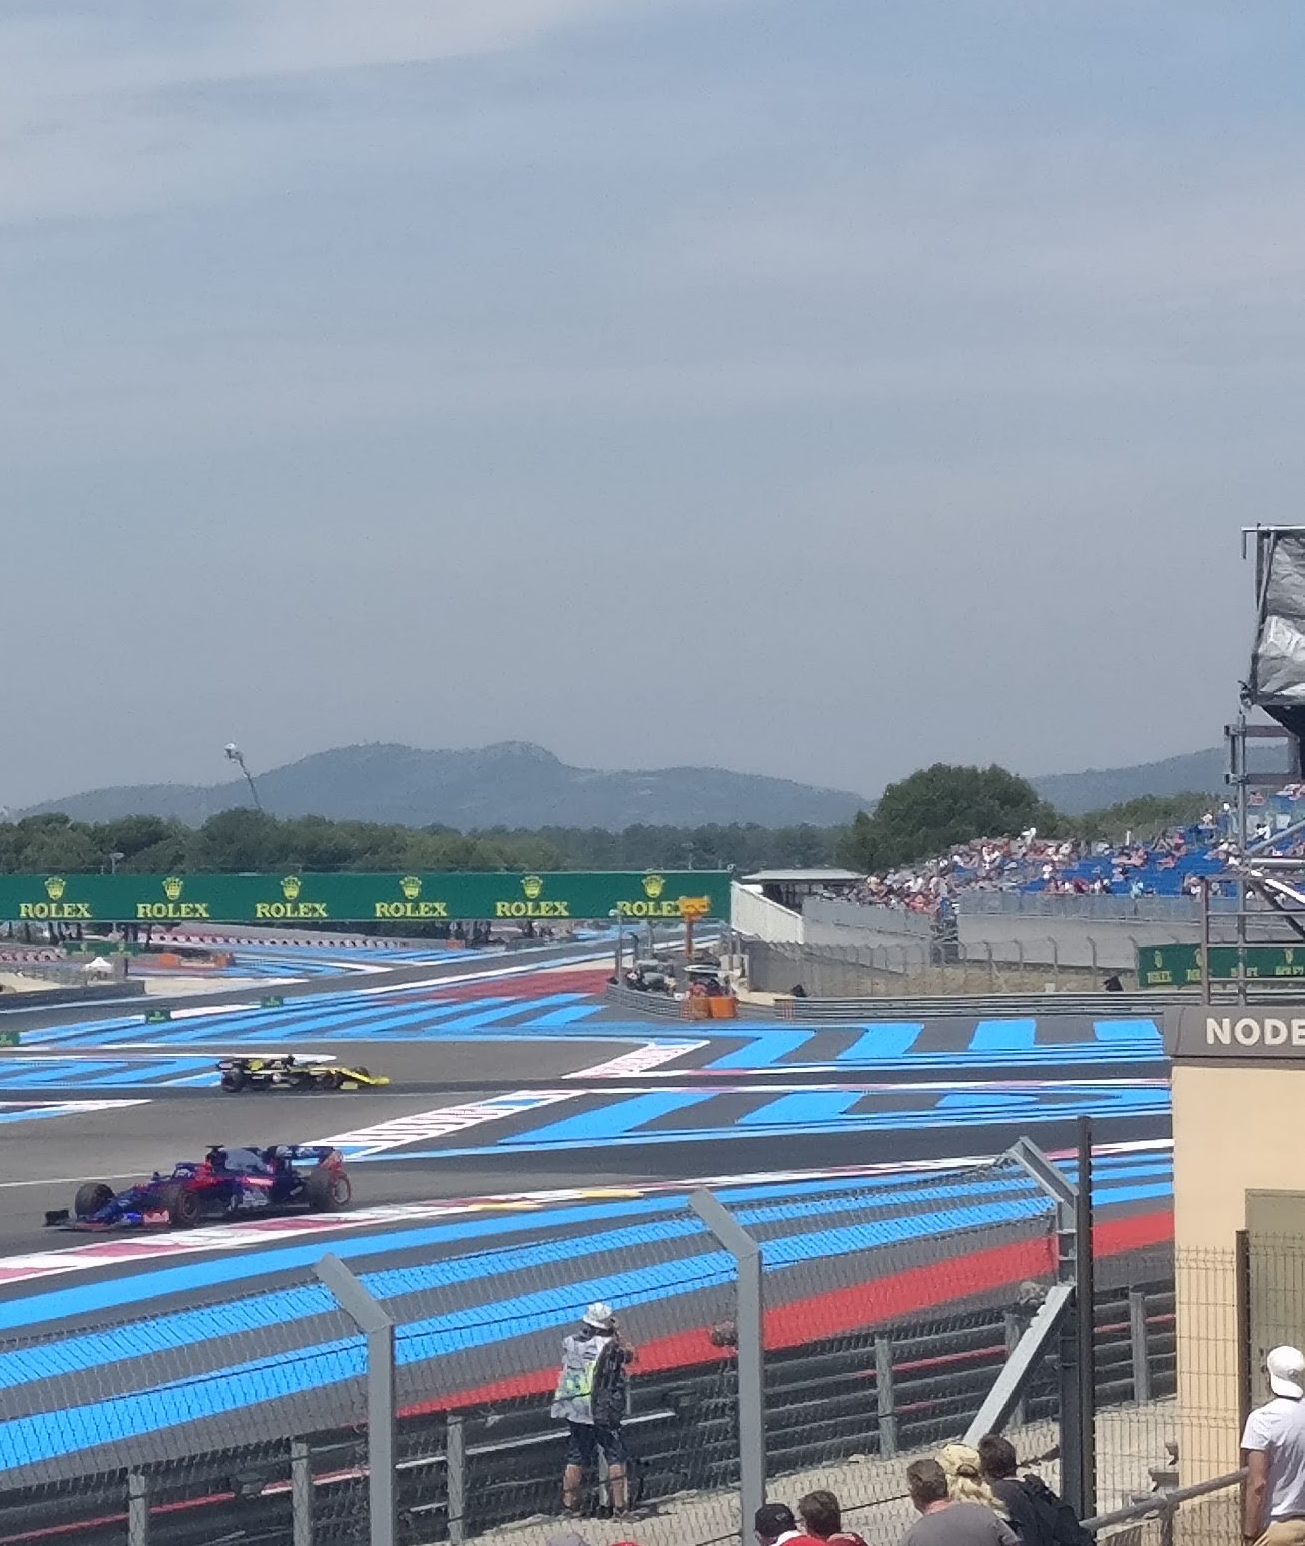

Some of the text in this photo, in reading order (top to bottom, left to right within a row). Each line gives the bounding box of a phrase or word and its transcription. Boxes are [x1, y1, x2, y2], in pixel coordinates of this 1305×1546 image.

[19, 903, 92, 919] ROLEX
[136, 902, 210, 918] ROLEX
[255, 902, 328, 918] ROLEX
[375, 901, 448, 918] ROLEX
[495, 900, 570, 917] ROLEX
[616, 900, 682, 917] ROLE
[1206, 1017, 1305, 1046] NODE
